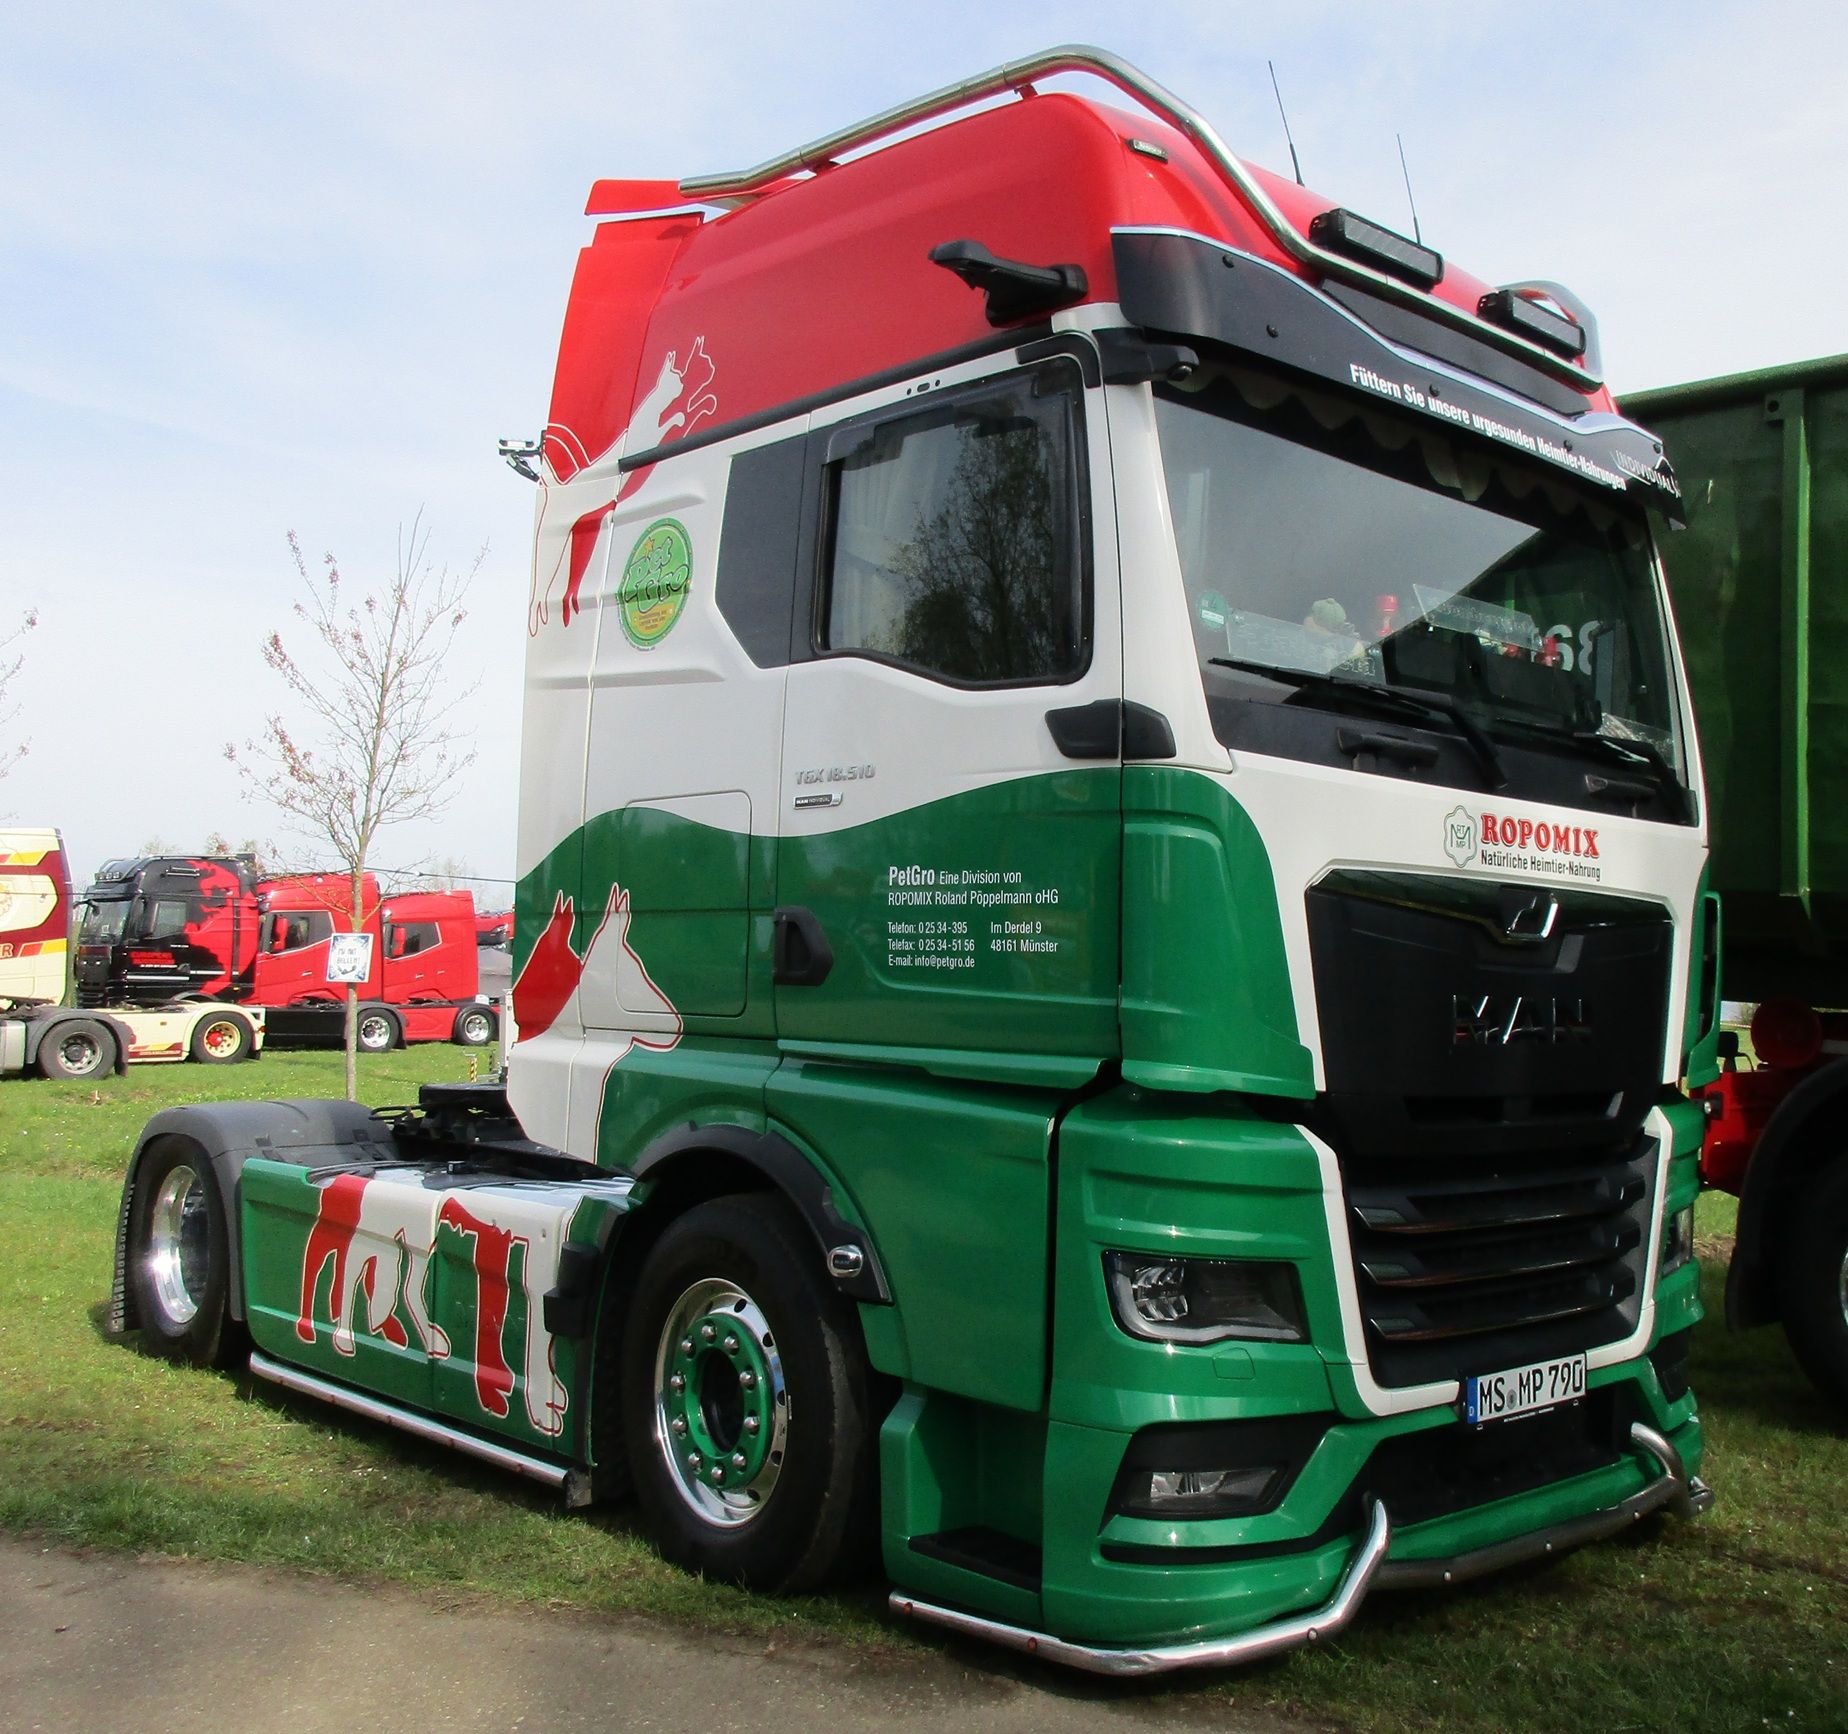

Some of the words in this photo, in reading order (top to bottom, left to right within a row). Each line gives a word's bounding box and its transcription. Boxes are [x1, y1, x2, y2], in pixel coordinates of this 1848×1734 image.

[1350, 363, 1401, 399] Füttern
[1403, 383, 1425, 407] Sie
[1427, 396, 1470, 424] unsere
[1472, 413, 1536, 452] urgesunden
[1536, 435, 1627, 491] Heimtier-Nahrungen
[827, 763, 876, 782] 18.510
[1480, 812, 1600, 859] ROPOMIX
[1481, 849, 1528, 870] Natürliche
[1530, 855, 1601, 882] Heimtier-Nahrung
[889, 864, 935, 887] PetGro
[940, 871, 959, 885] Eine
[962, 870, 1000, 884] Division
[1003, 871, 1022, 884] von
[888, 892, 932, 906] ROPOMIX
[935, 891, 967, 906] Roland
[970, 890, 1032, 908] Pöppelmann
[1035, 889, 1059, 904] oHG
[888, 921, 917, 934] Telefon:
[991, 921, 1002, 934] Im
[1004, 921, 1033, 934] Derdel
[1035, 921, 1042, 933] 9
[888, 939, 916, 951] Telefax:
[991, 939, 1017, 952] 48161
[1020, 939, 1059, 952] Münster
[888, 955, 913, 967] E-mail:
[914, 954, 975, 969] info@petgro.de
[1478, 1376, 1505, 1417] MS
[1518, 1368, 1543, 1407] MP
[1548, 1359, 1583, 1399] 790
